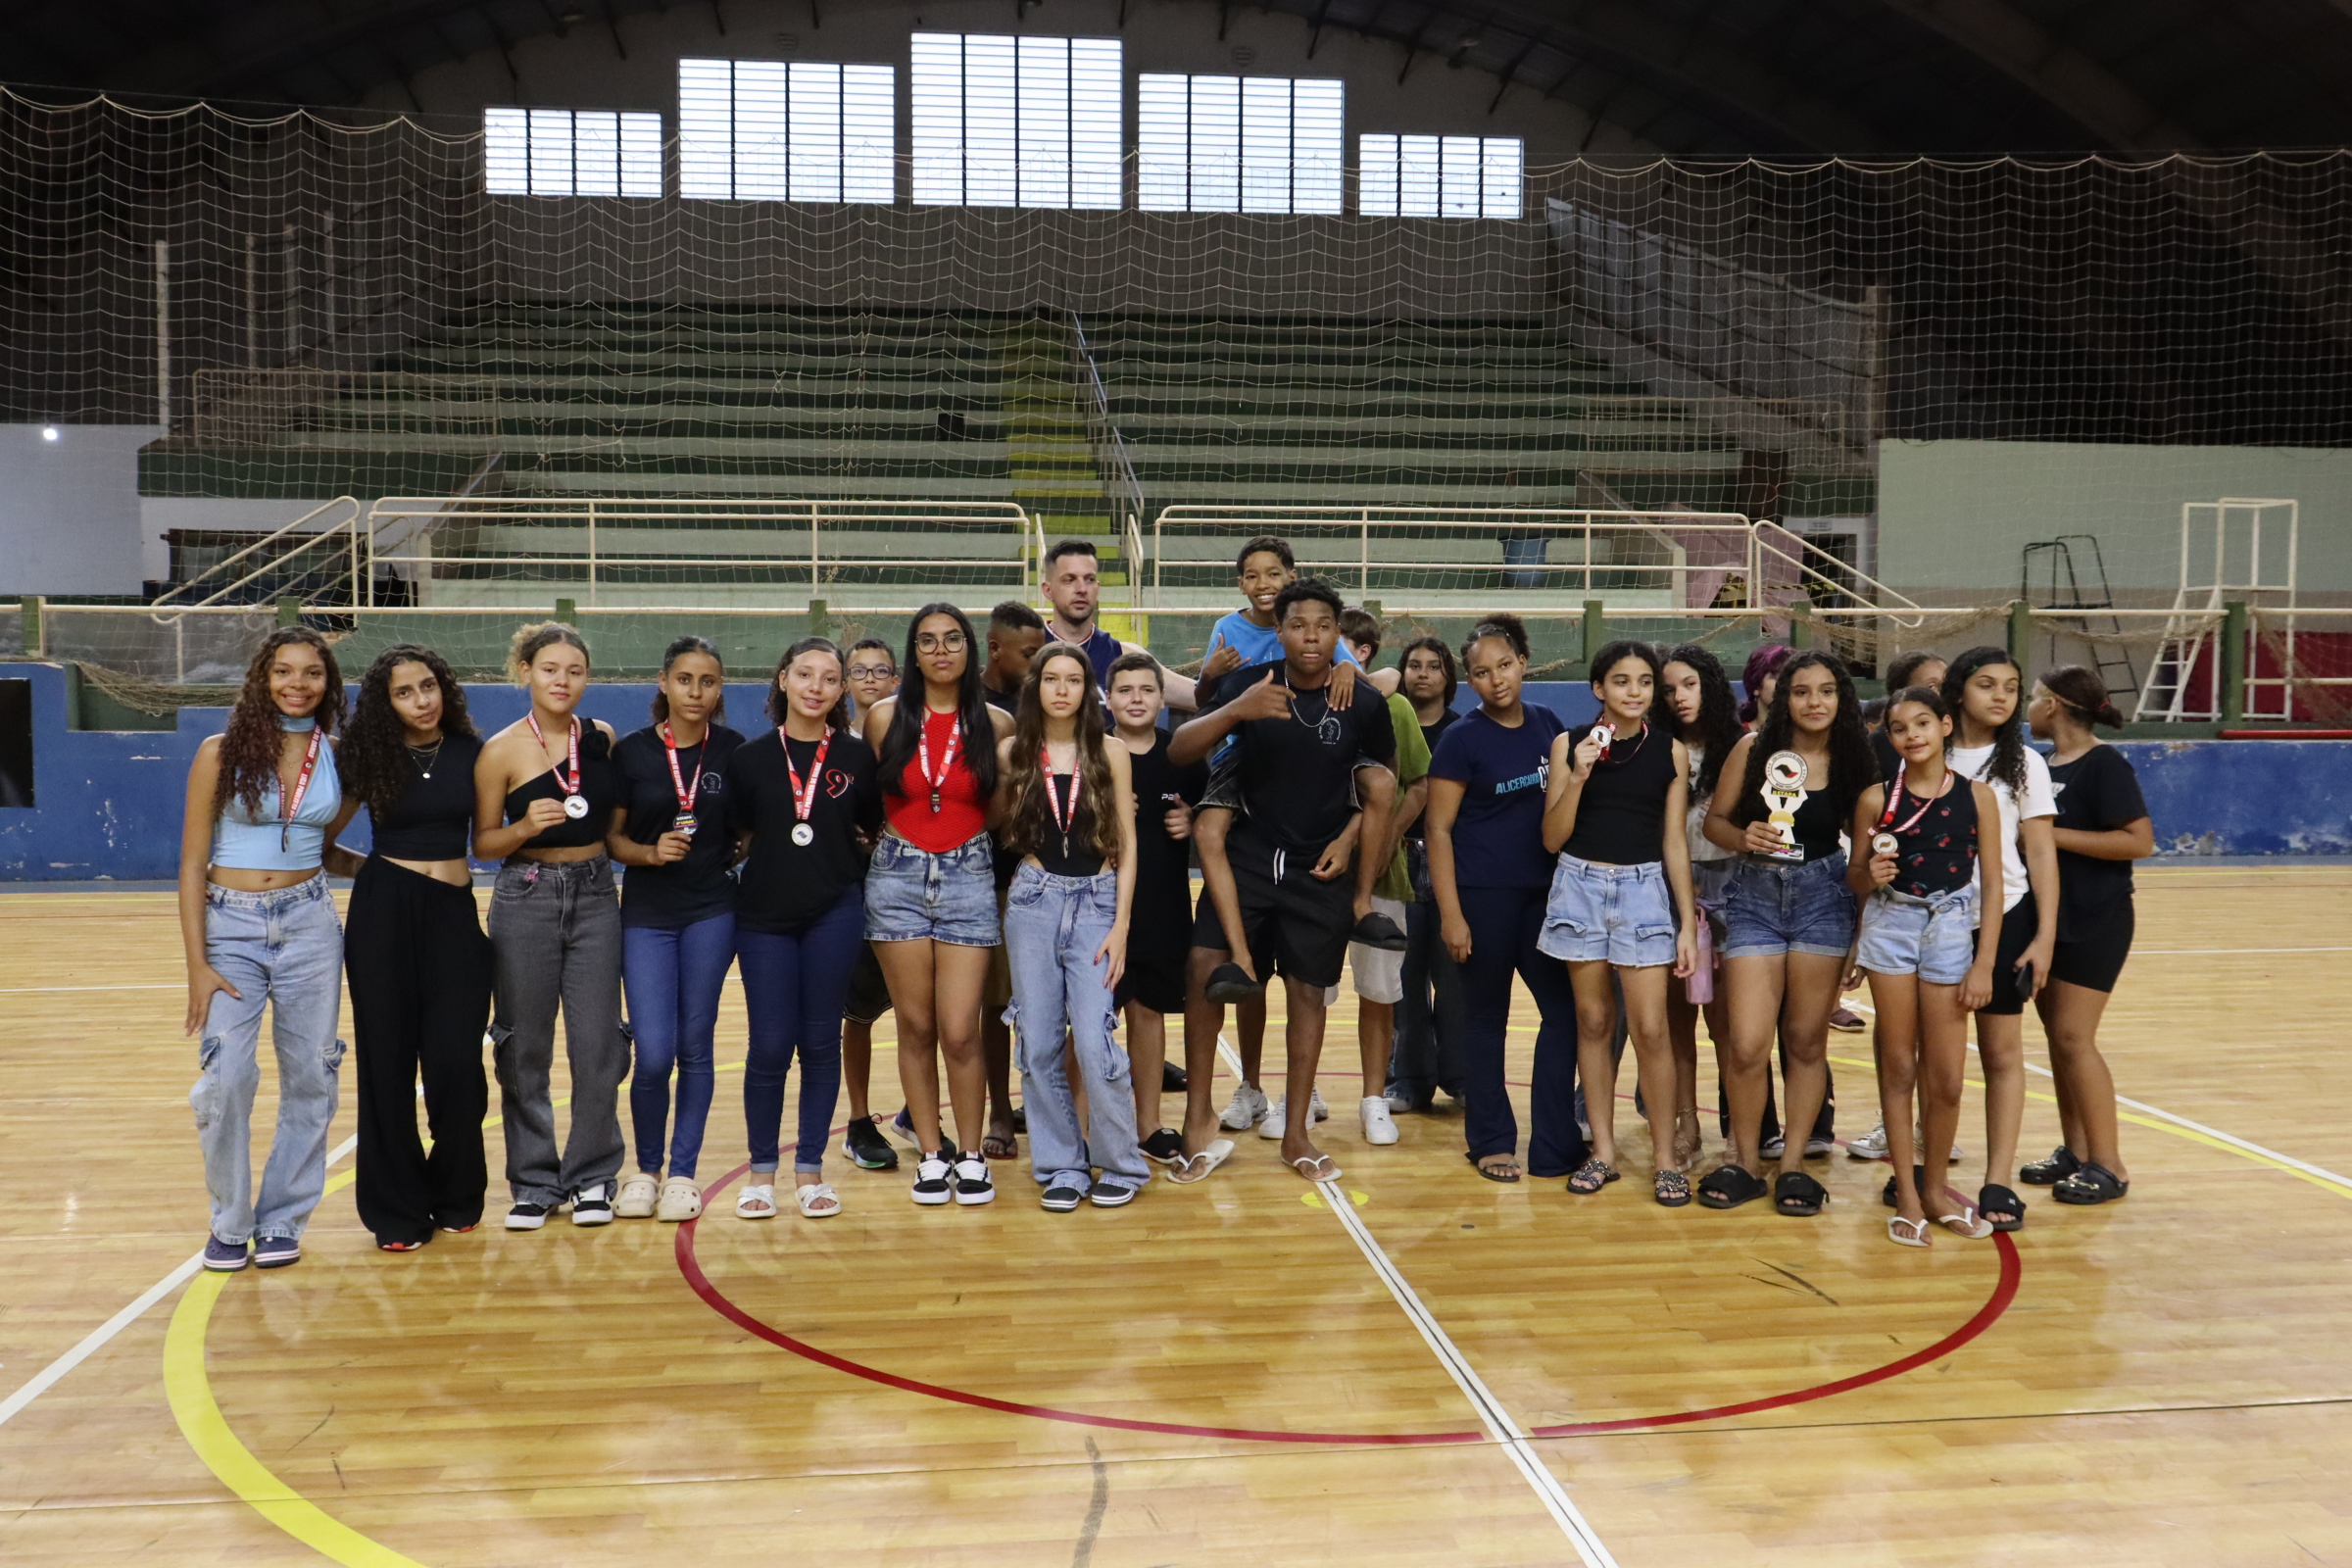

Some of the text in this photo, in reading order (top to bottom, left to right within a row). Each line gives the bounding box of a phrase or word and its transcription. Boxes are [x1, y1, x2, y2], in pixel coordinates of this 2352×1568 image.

[298, 773, 308, 785] LIGA
[1070, 777, 1080, 802] PAULISTA
[291, 785, 305, 810] PAULISTA
[804, 784, 816, 808] PAULISTA
[1050, 788, 1059, 812] PAULISTA
[802, 808, 810, 820] LIGA
